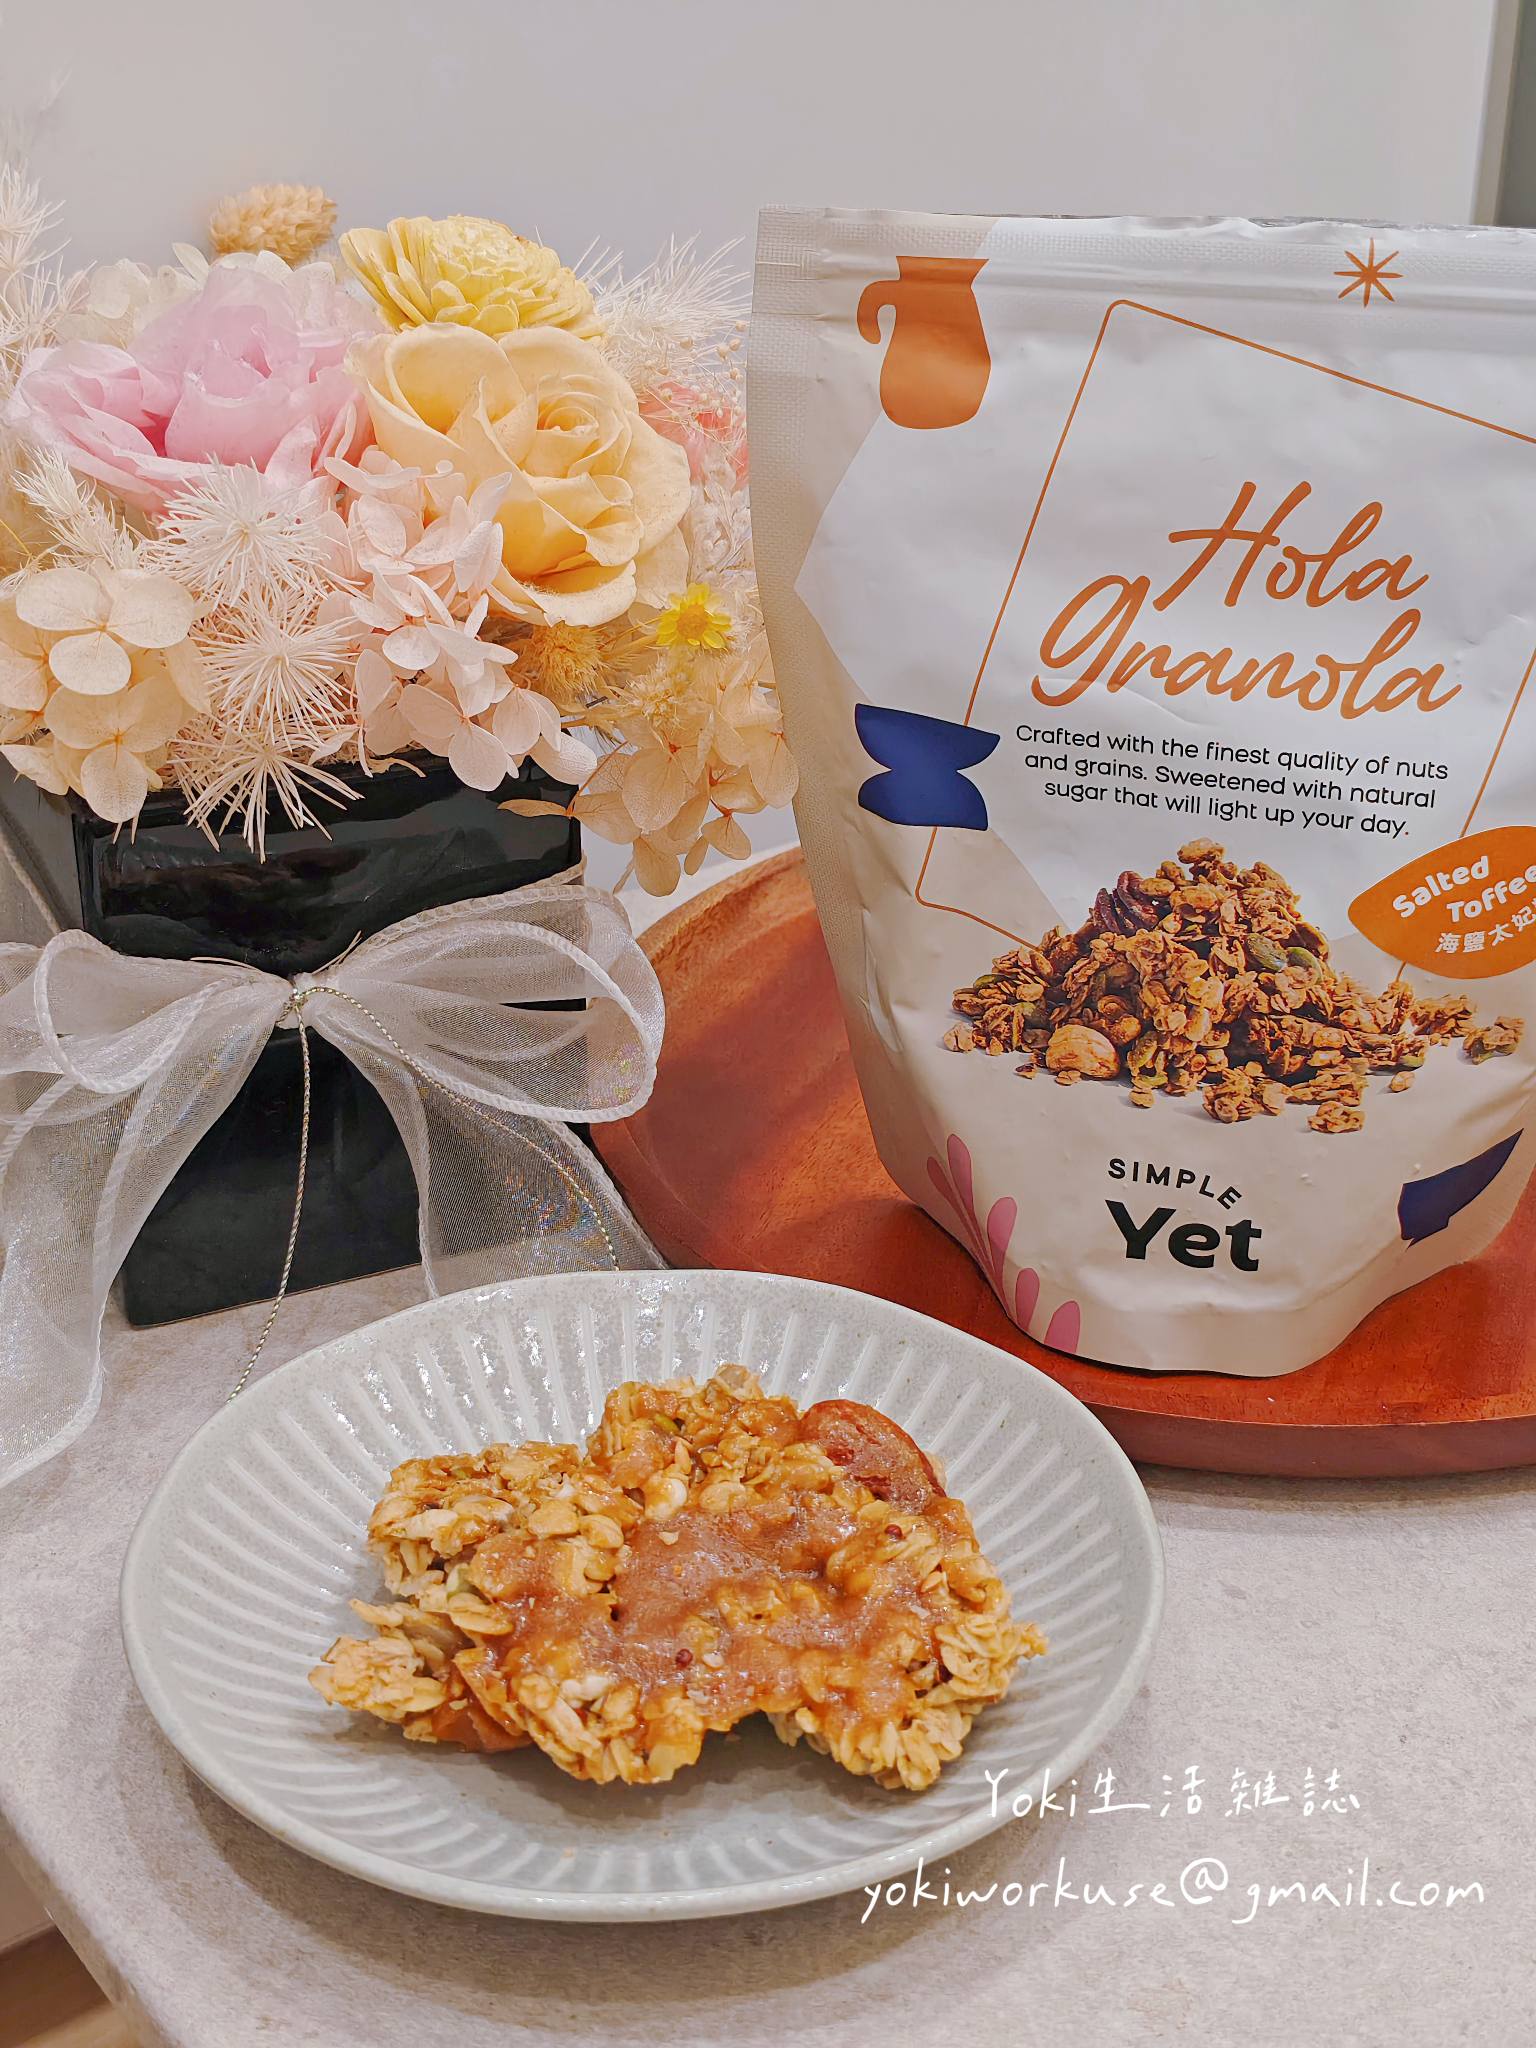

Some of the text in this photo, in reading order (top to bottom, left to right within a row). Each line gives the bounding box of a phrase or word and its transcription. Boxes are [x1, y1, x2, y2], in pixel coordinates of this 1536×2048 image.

[1153, 481, 1429, 611] Hola
[1016, 724, 1449, 780] Crafted with the finest quality of nuts
[1025, 754, 1436, 809] and grains. Sweetened with natural
[1044, 782, 1409, 839] sugar that will light up your day.
[1392, 855, 1490, 918] Salted
[1435, 897, 1536, 954] 海鹽太妃
[1108, 1157, 1242, 1210] SIMPLE
[1104, 1199, 1262, 1272] Yet
